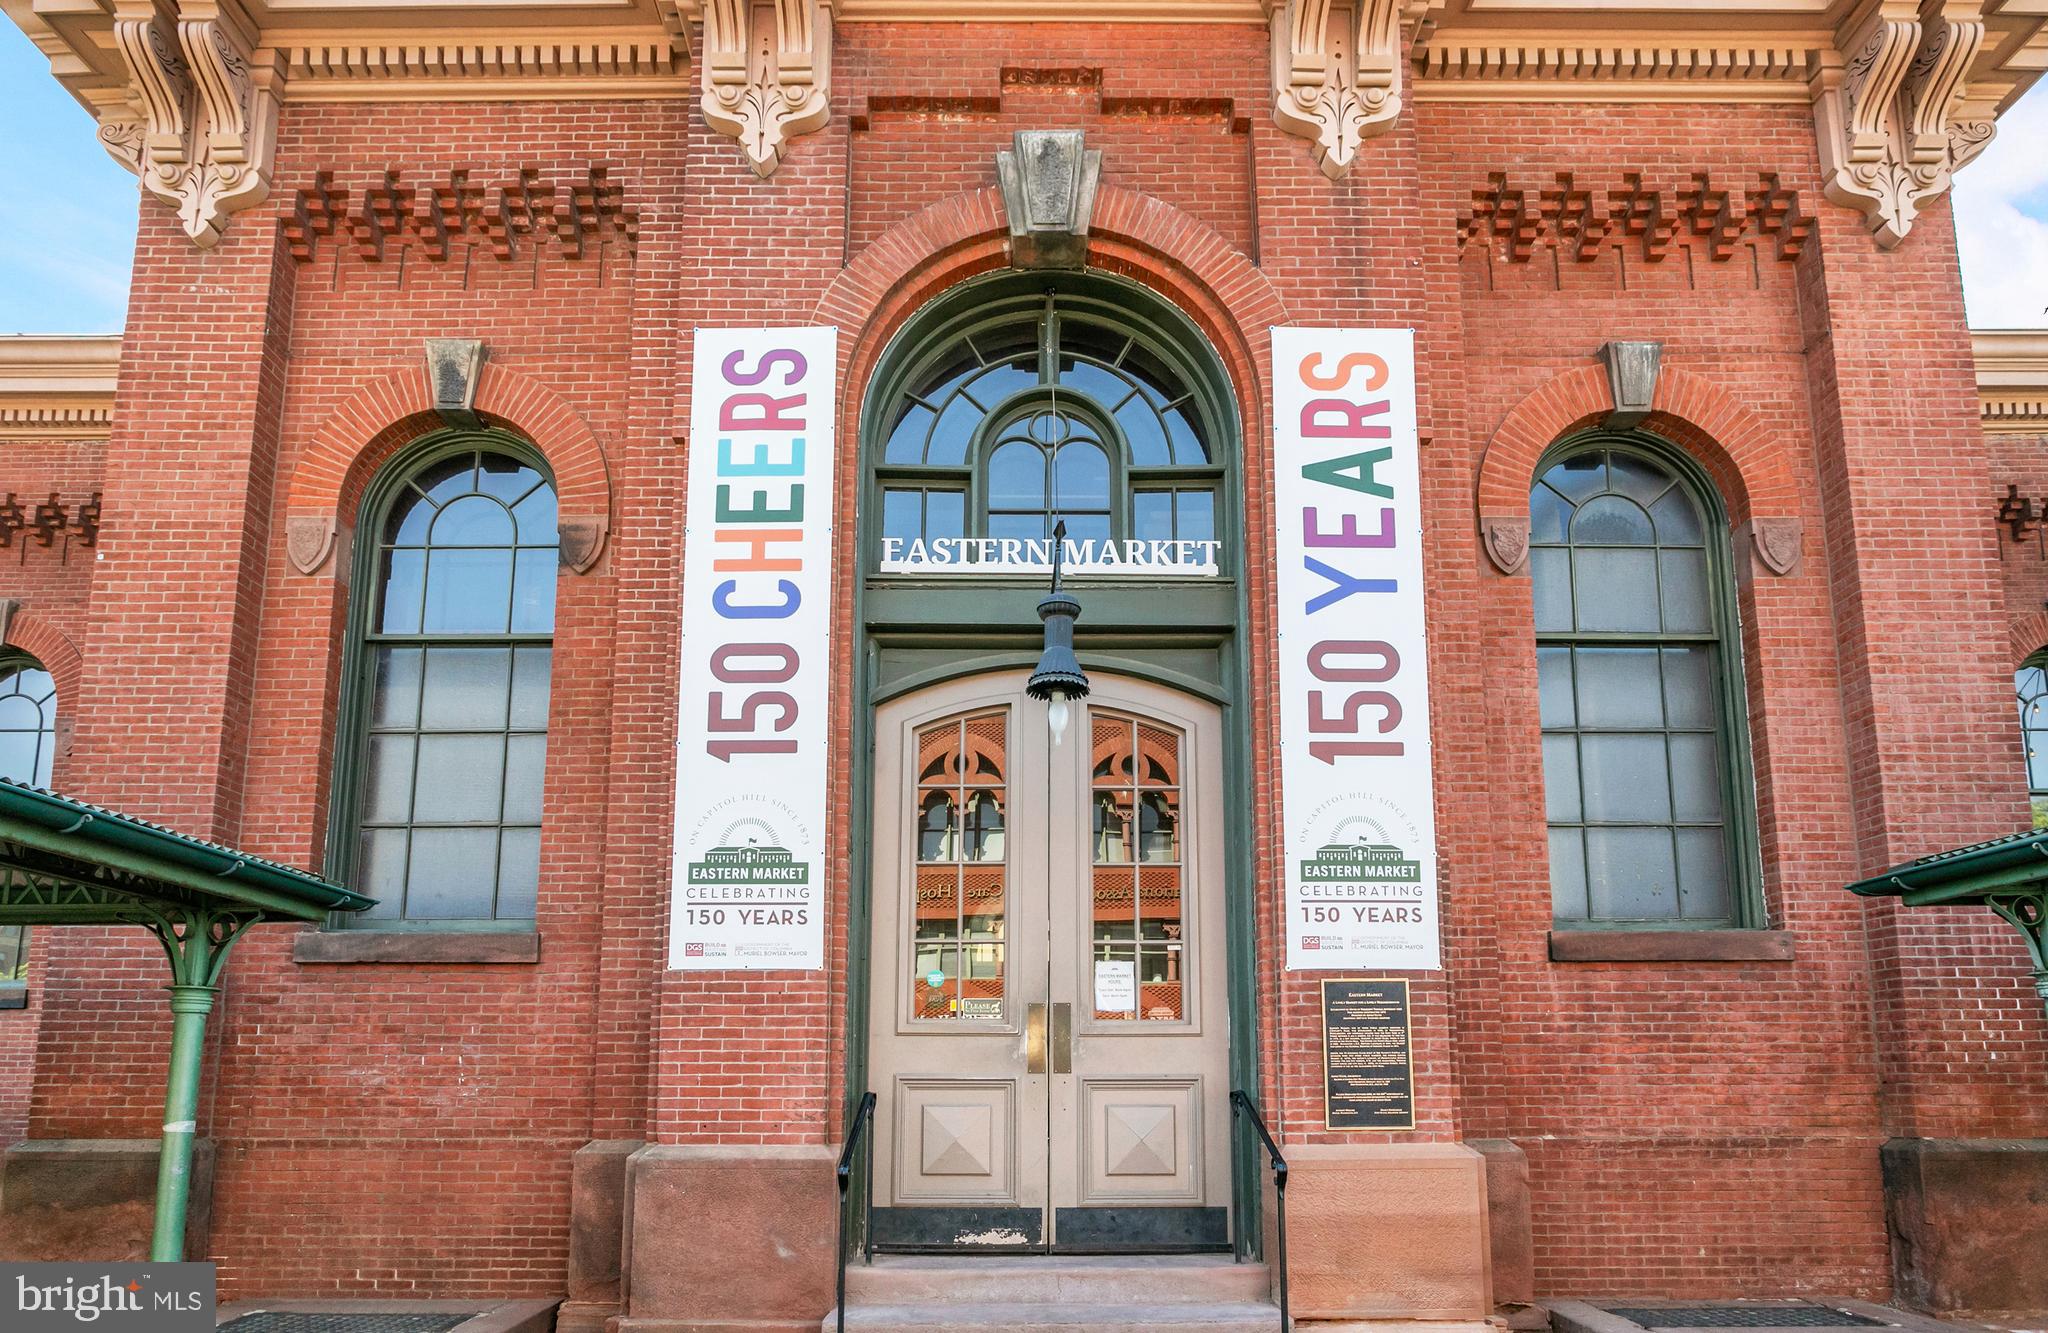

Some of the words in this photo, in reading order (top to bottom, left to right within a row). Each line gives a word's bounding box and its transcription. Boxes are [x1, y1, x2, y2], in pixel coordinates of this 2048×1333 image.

[712, 349, 808, 619] CHEERS
[1299, 352, 1398, 615] YEARS
[881, 537, 1053, 566] EASTERN
[1062, 538, 1222, 567] MARKET
[707, 643, 800, 763] 150
[1307, 640, 1405, 765] 150
[697, 795, 737, 828] CAPITOL
[742, 793, 767, 802] HILL
[771, 798, 799, 822] SINCE
[1307, 794, 1345, 825] CAPITOL
[1349, 792, 1375, 801] HILL
[1379, 797, 1407, 819] SINCE
[692, 867, 749, 880] EASTERN
[752, 867, 804, 880] MARKET
[1305, 865, 1361, 877] EASTERN
[1365, 865, 1416, 877] MARKET
[686, 887, 810, 899] CELEBRATING
[1300, 885, 1423, 897] CELEBRATING
[687, 909, 725, 925] 150
[738, 909, 809, 925] YEARS
[1301, 906, 1340, 923] 150
[1352, 906, 1423, 923] YEARS
[965, 1000, 991, 1009] PLEASE
